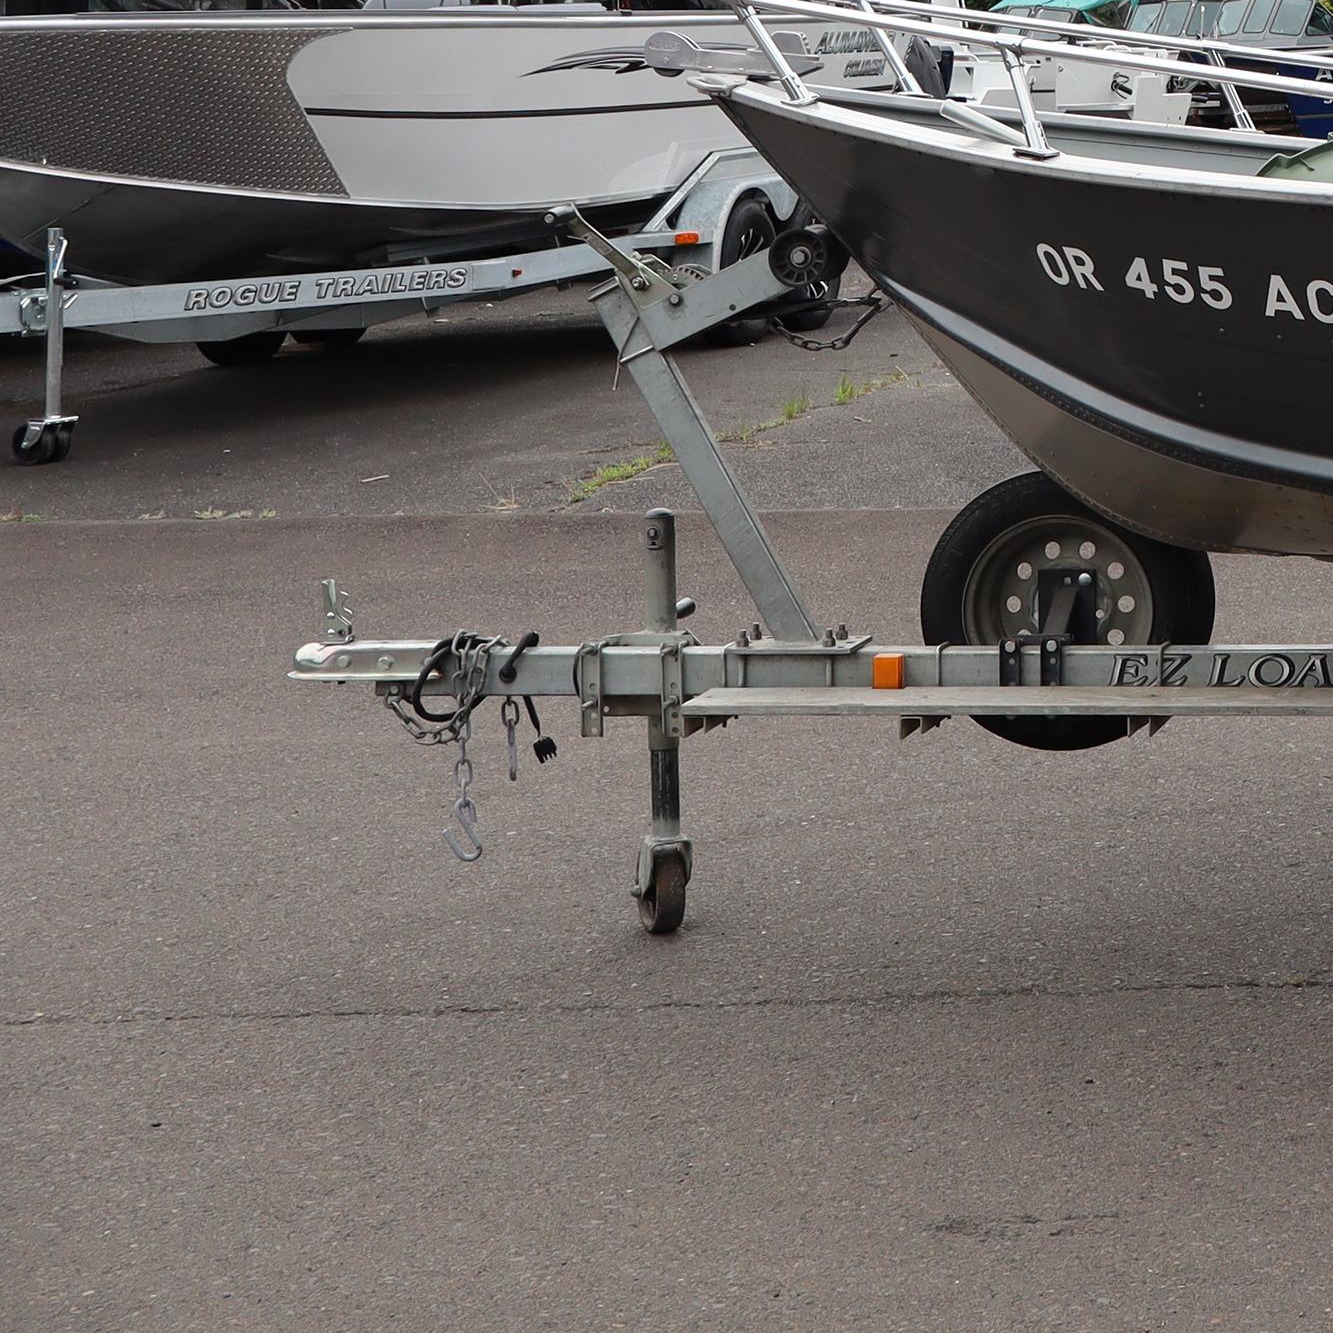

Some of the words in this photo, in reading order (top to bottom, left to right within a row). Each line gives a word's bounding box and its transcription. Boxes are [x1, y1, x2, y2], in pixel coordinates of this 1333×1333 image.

[814, 30, 897, 55] ALUMAWE
[184, 280, 301, 311] ROGUE
[315, 267, 467, 299] TRAILERS
[1036, 242, 1105, 292] OR
[1125, 257, 1233, 310] 455
[1109, 653, 1193, 688] EZ
